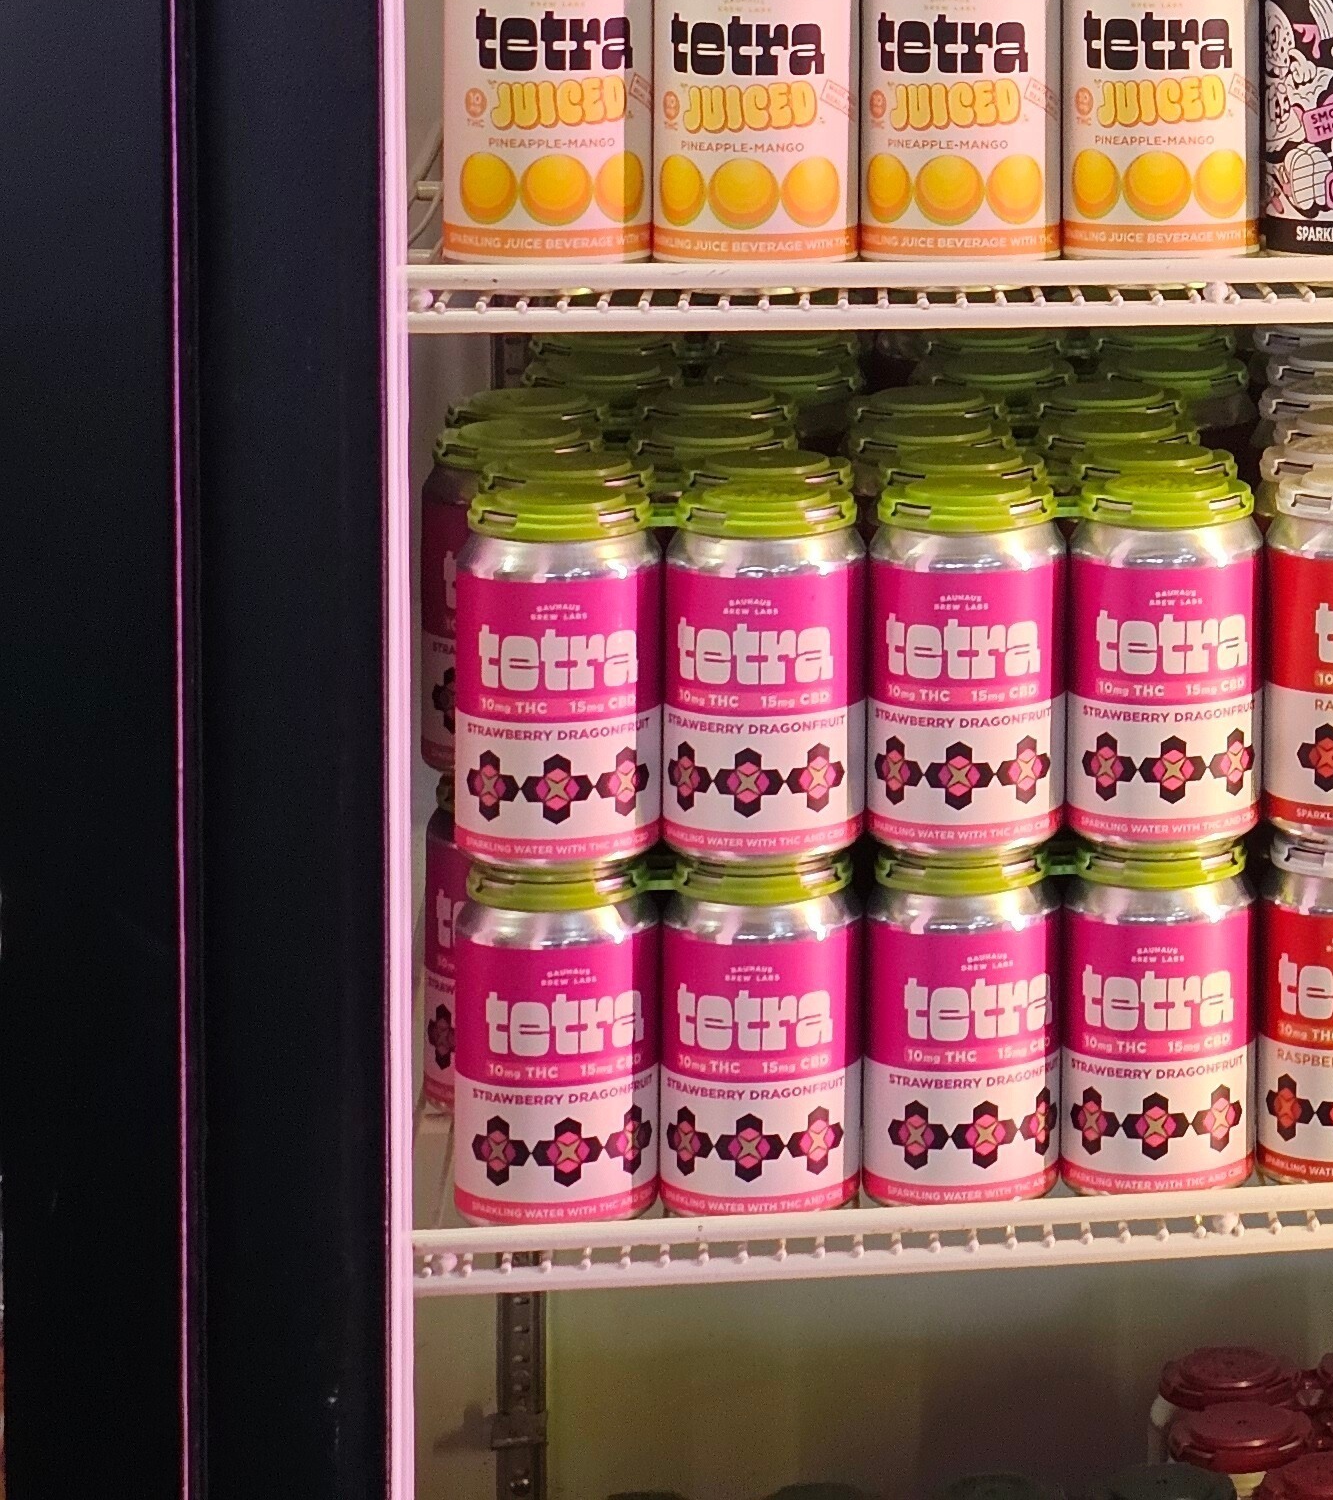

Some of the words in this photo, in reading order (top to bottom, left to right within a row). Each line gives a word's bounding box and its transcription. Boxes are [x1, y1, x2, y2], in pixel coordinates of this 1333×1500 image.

[476, 9, 633, 71] tetra
[671, 12, 825, 75] tetra
[877, 12, 1029, 73] tetra
[1083, 10, 1232, 70] tetra
[490, 76, 626, 130] JUICED
[683, 81, 817, 134] JUICED
[890, 79, 1021, 131] JUICED
[1097, 74, 1225, 128] JUICED
[488, 137, 615, 148] PINEAPPLE-MANGO
[680, 141, 804, 153] PINEAPPLE-MANGO
[887, 138, 1008, 150] PINEAPPLE-MANGO
[1095, 135, 1215, 146] PINEAPPLE-MANGO
[478, 623, 638, 691] tetra
[678, 617, 834, 686] tetra
[886, 612, 1040, 680] tetra
[1096, 609, 1248, 677] tetra
[1083, 705, 1170, 723] STRAWBERRY
[1174, 700, 1255, 723] DRAGONFRUIT
[1132, 683, 1164, 697] THC
[1185, 683, 1218, 697] 15mg
[467, 722, 553, 741] STRAWBERRY
[557, 717, 649, 741] DRAGONFRUIT
[667, 714, 745, 735] STRAWBERRY
[748, 714, 846, 735] DRAGONFRUIT
[875, 708, 955, 728] STRAWBERRY
[959, 708, 1051, 729] DRAGONFRUIT
[485, 990, 645, 1057] tetra
[677, 983, 833, 1051] tetra
[904, 973, 1053, 1041] tetra
[1082, 964, 1234, 1032] tetra
[472, 1088, 564, 1106] STRAWBERRY
[568, 1074, 653, 1104] DRAGONFRUIT
[488, 1063, 521, 1079] 10mg
[524, 1064, 559, 1079] THC
[579, 1061, 613, 1076] 15mg
[666, 1079, 746, 1101] STRAWBERRY
[749, 1075, 845, 1101] DRAGONFRUIT
[889, 1073, 982, 1089] STRAWBERRY
[986, 1059, 1059, 1087] DRAGONFRUIT
[1071, 1058, 1152, 1080] STRAWBERRY
[1156, 1055, 1243, 1080] DRAGONFRUIT
